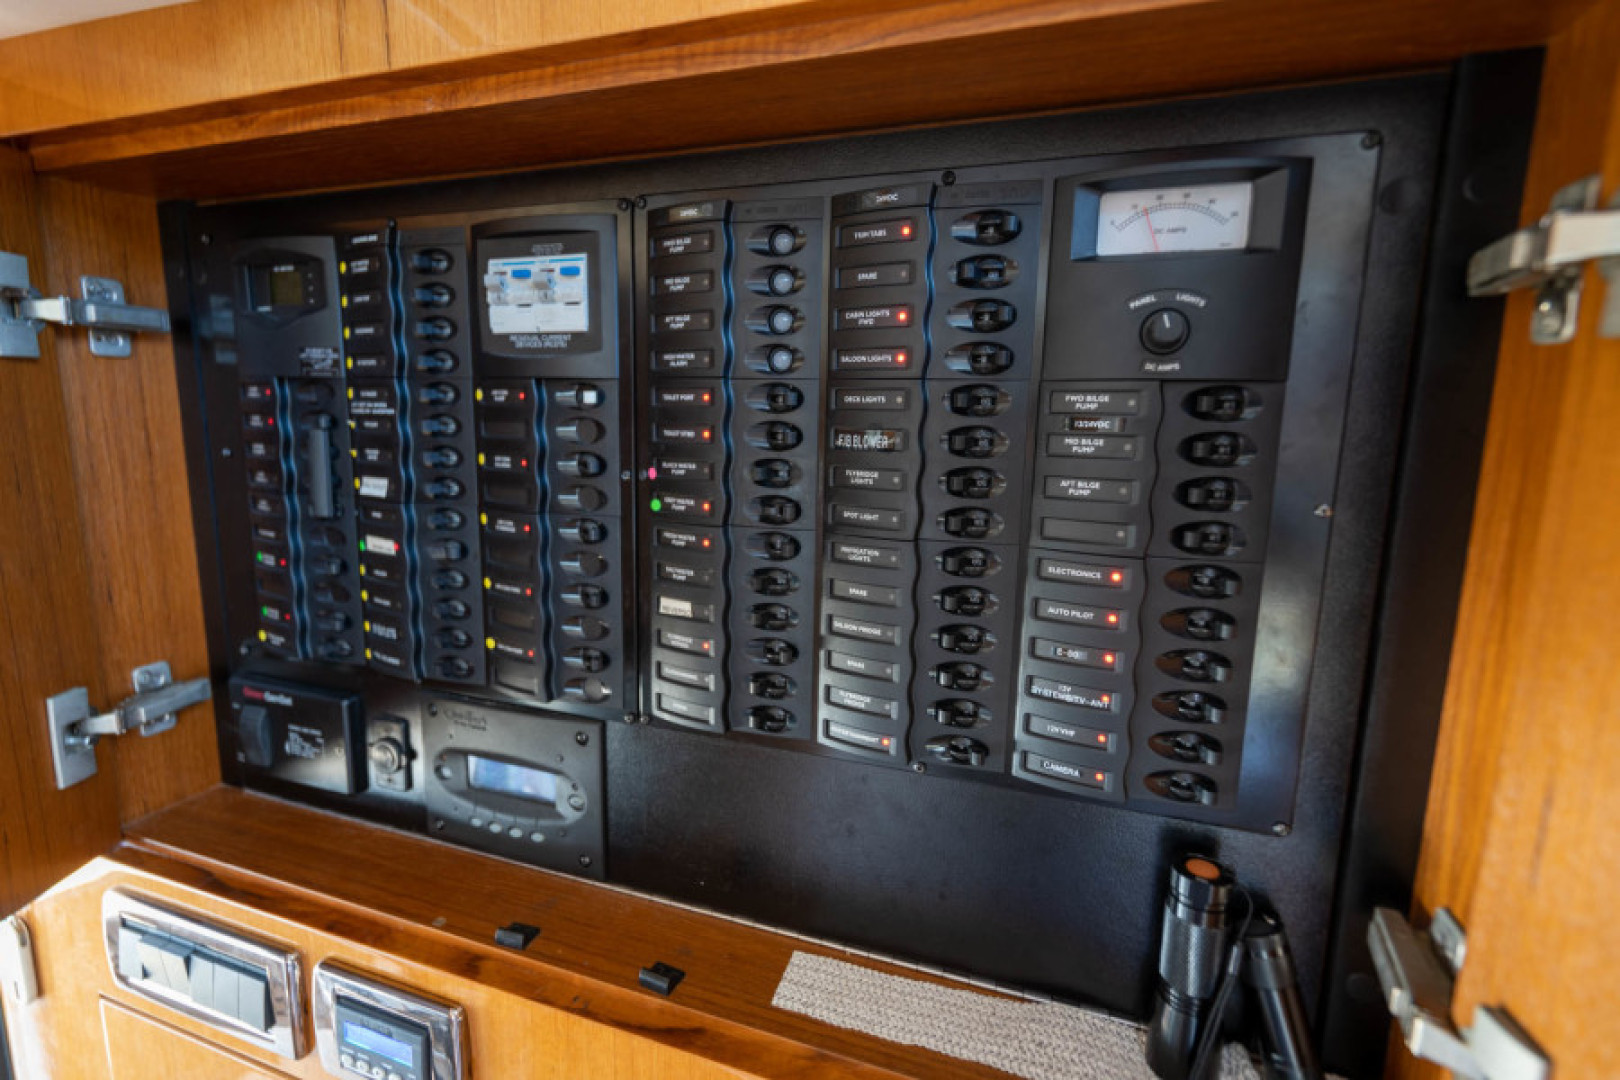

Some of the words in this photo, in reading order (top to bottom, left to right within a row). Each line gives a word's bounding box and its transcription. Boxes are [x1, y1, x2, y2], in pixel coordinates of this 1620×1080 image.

[1129, 294, 1157, 310] PANEL
[1176, 292, 1206, 307] LIGHTS
[845, 311, 865, 320] CABIN
[865, 309, 890, 318] LIGHTS
[841, 355, 866, 363] SALOON
[867, 353, 892, 363] LIGHTS
[1144, 362, 1156, 372] DC
[1157, 361, 1181, 372] AMPS
[844, 395, 861, 403] DECK
[862, 395, 886, 404] LIGHTS
[1065, 394, 1084, 403] FWD
[1085, 395, 1110, 403] BILGE
[1075, 402, 1099, 410] PUMP
[853, 434, 888, 450] BLOWER
[1080, 437, 1104, 447] BILGE
[1072, 445, 1095, 453] PUMP
[845, 469, 879, 479] FLYBRIDGE
[1077, 480, 1101, 489] BILGE
[1067, 487, 1092, 496] PUMP
[1047, 566, 1102, 580] ELECTRONICS
[1047, 605, 1070, 616] AUTO
[1070, 609, 1095, 620] PILOT
